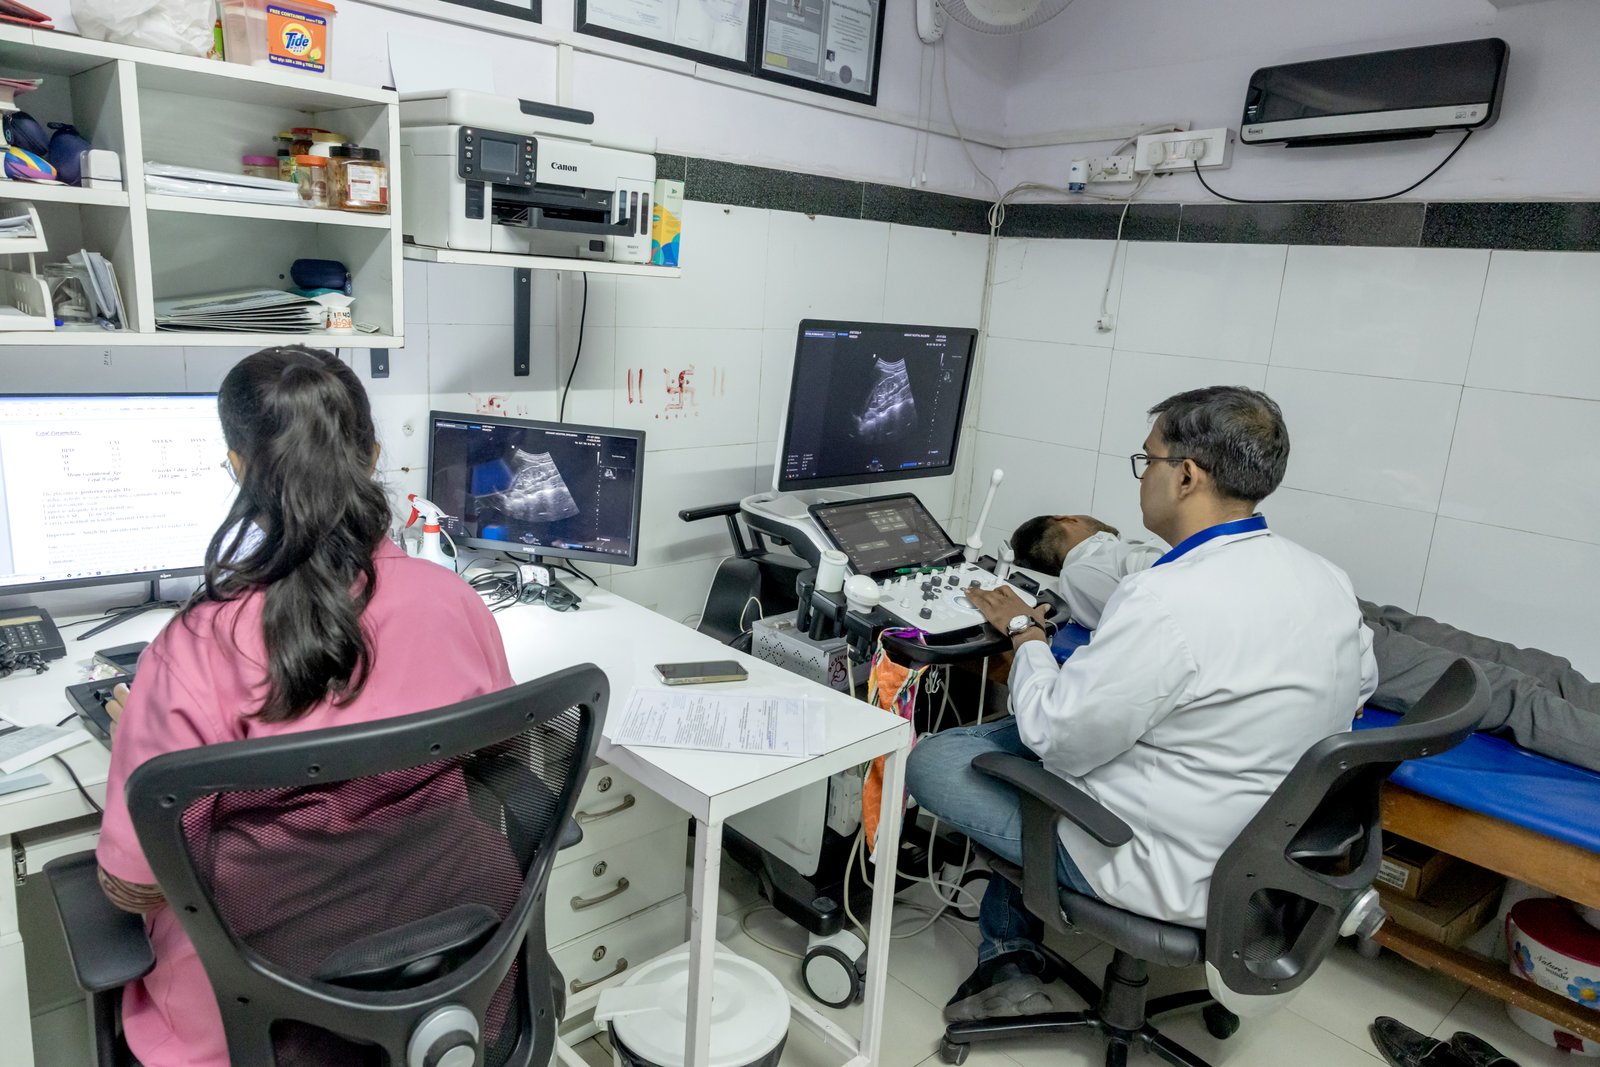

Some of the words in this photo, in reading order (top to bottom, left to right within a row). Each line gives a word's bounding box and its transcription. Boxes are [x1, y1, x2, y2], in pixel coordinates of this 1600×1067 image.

[285, 32, 310, 49] Tide
[551, 161, 578, 173] Canon
[1536, 955, 1569, 975] Nature's
